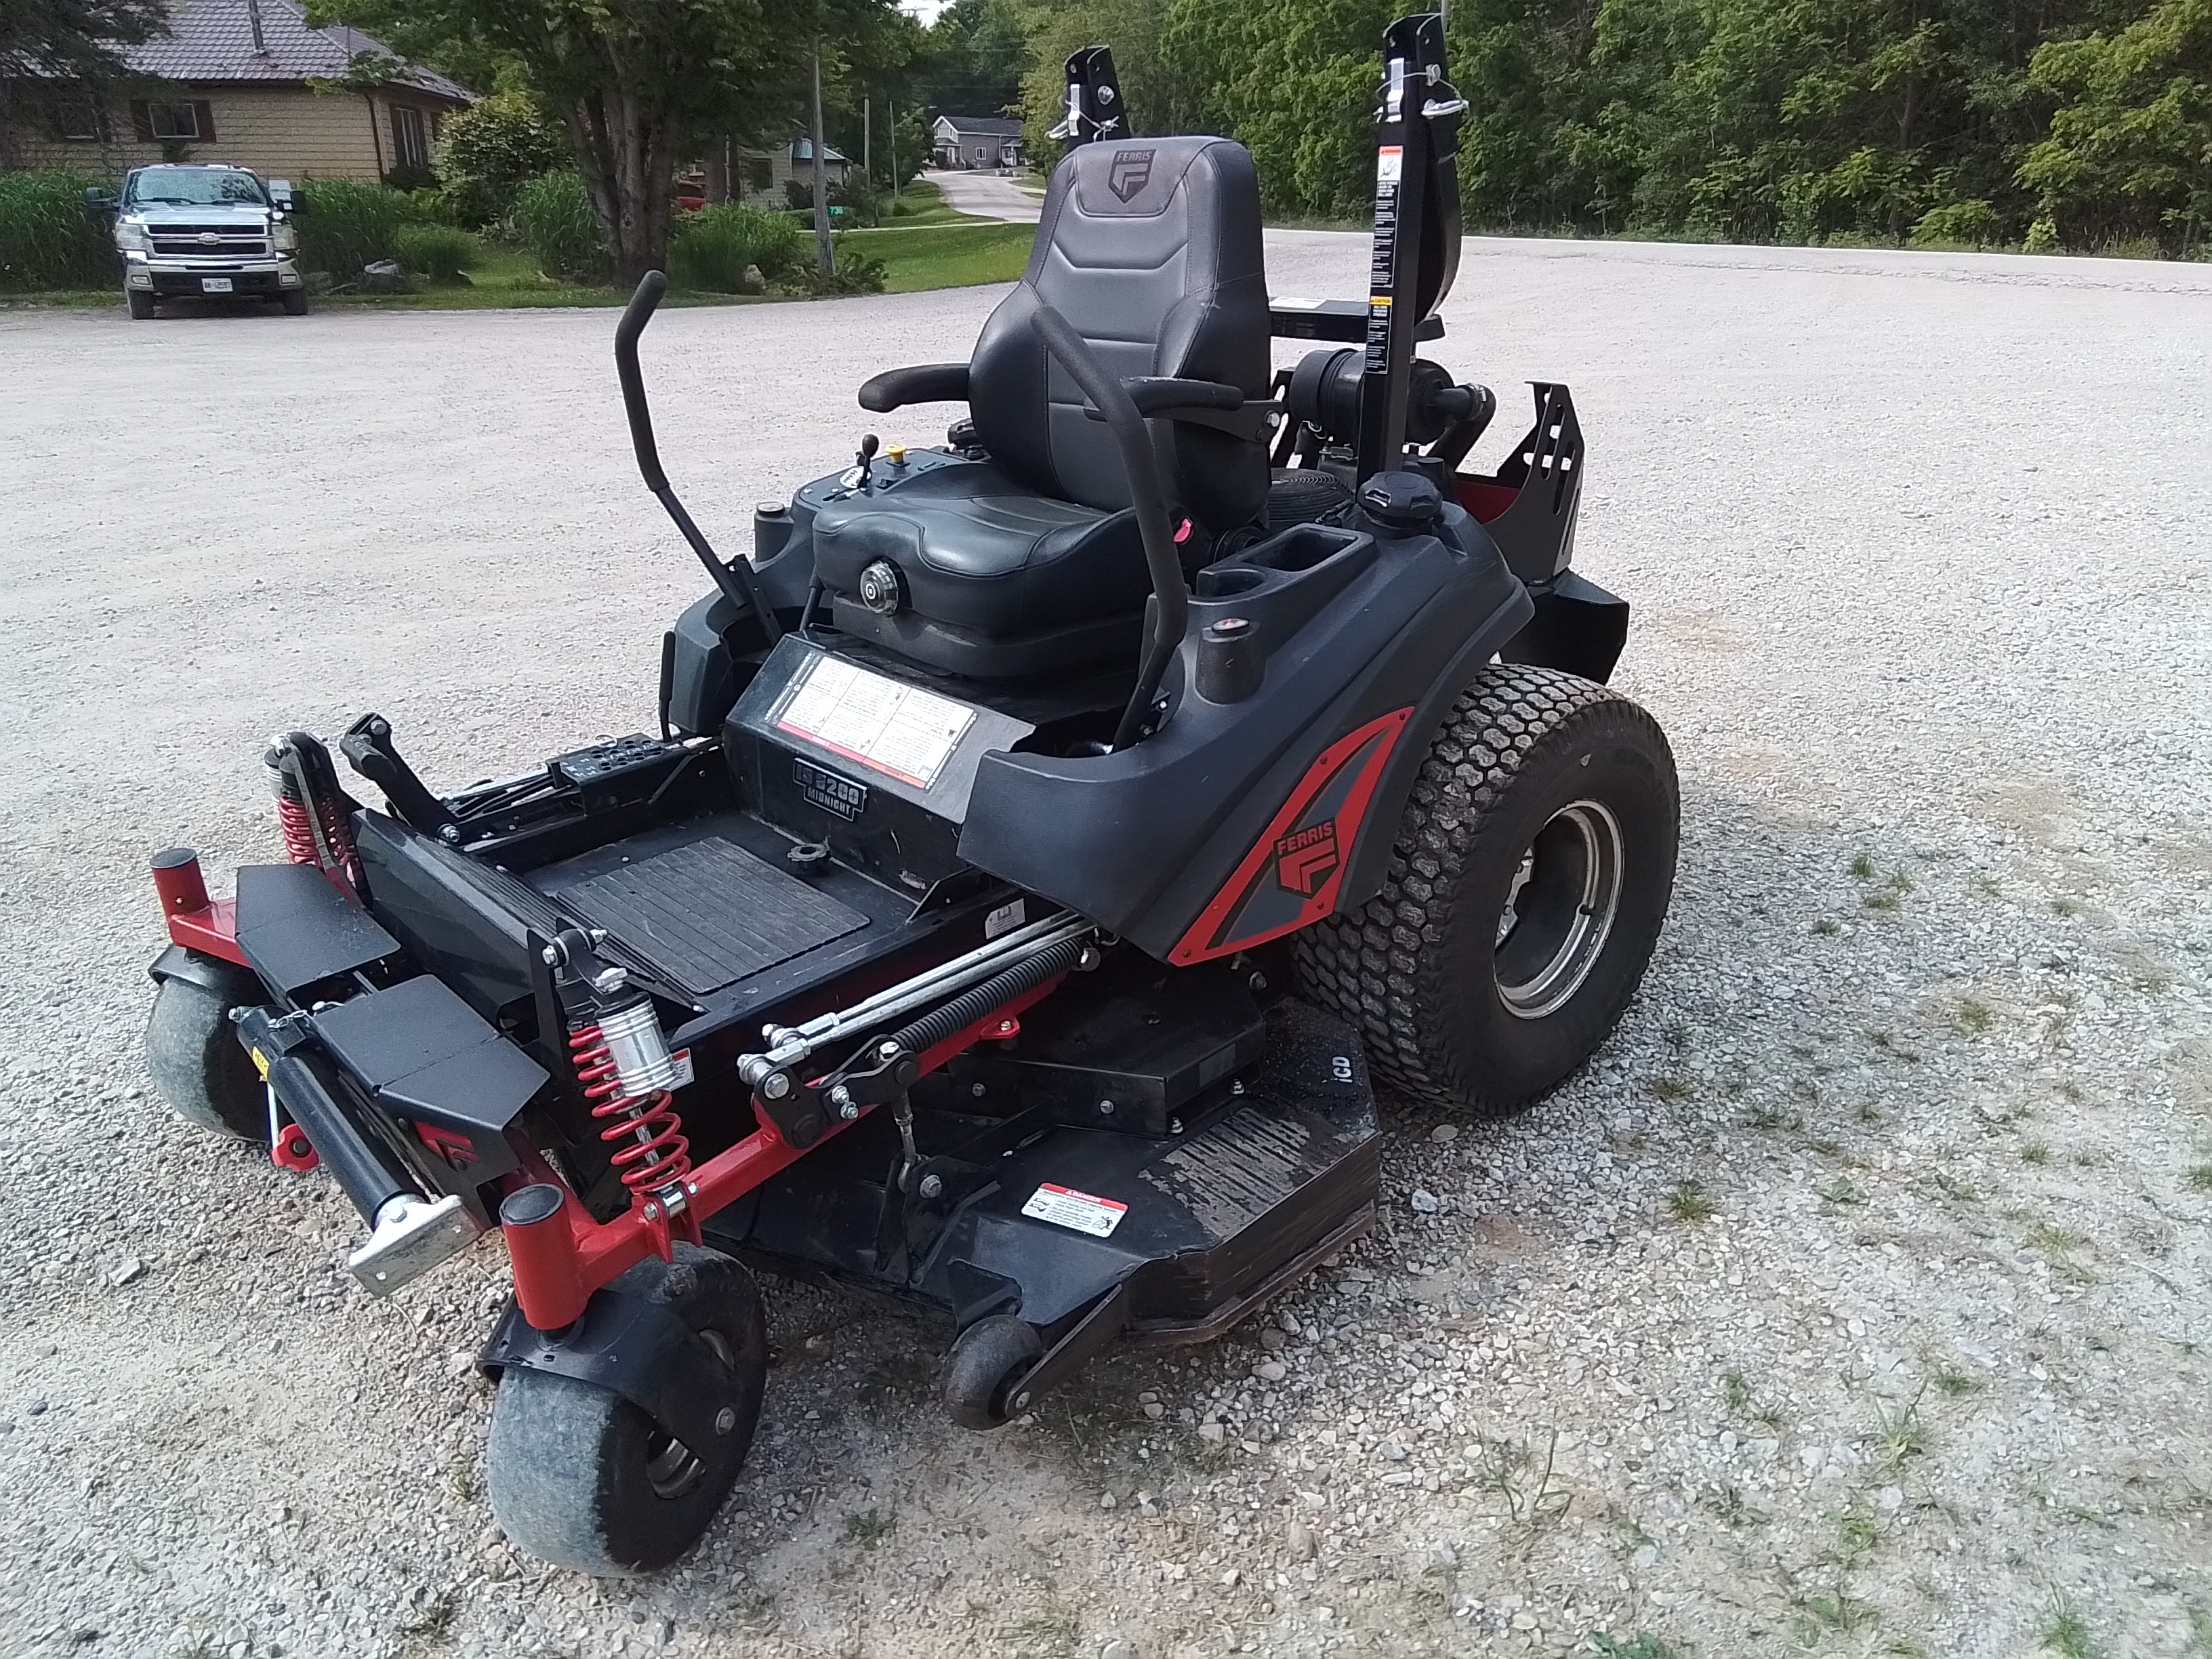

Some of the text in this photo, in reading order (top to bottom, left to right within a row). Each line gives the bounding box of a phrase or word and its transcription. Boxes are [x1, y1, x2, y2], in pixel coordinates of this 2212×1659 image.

[1116, 151, 1152, 162] FERRIS
[796, 764, 813, 784] IS
[807, 787, 851, 815] MIDNIGHT
[1277, 821, 1333, 856] FERRIS
